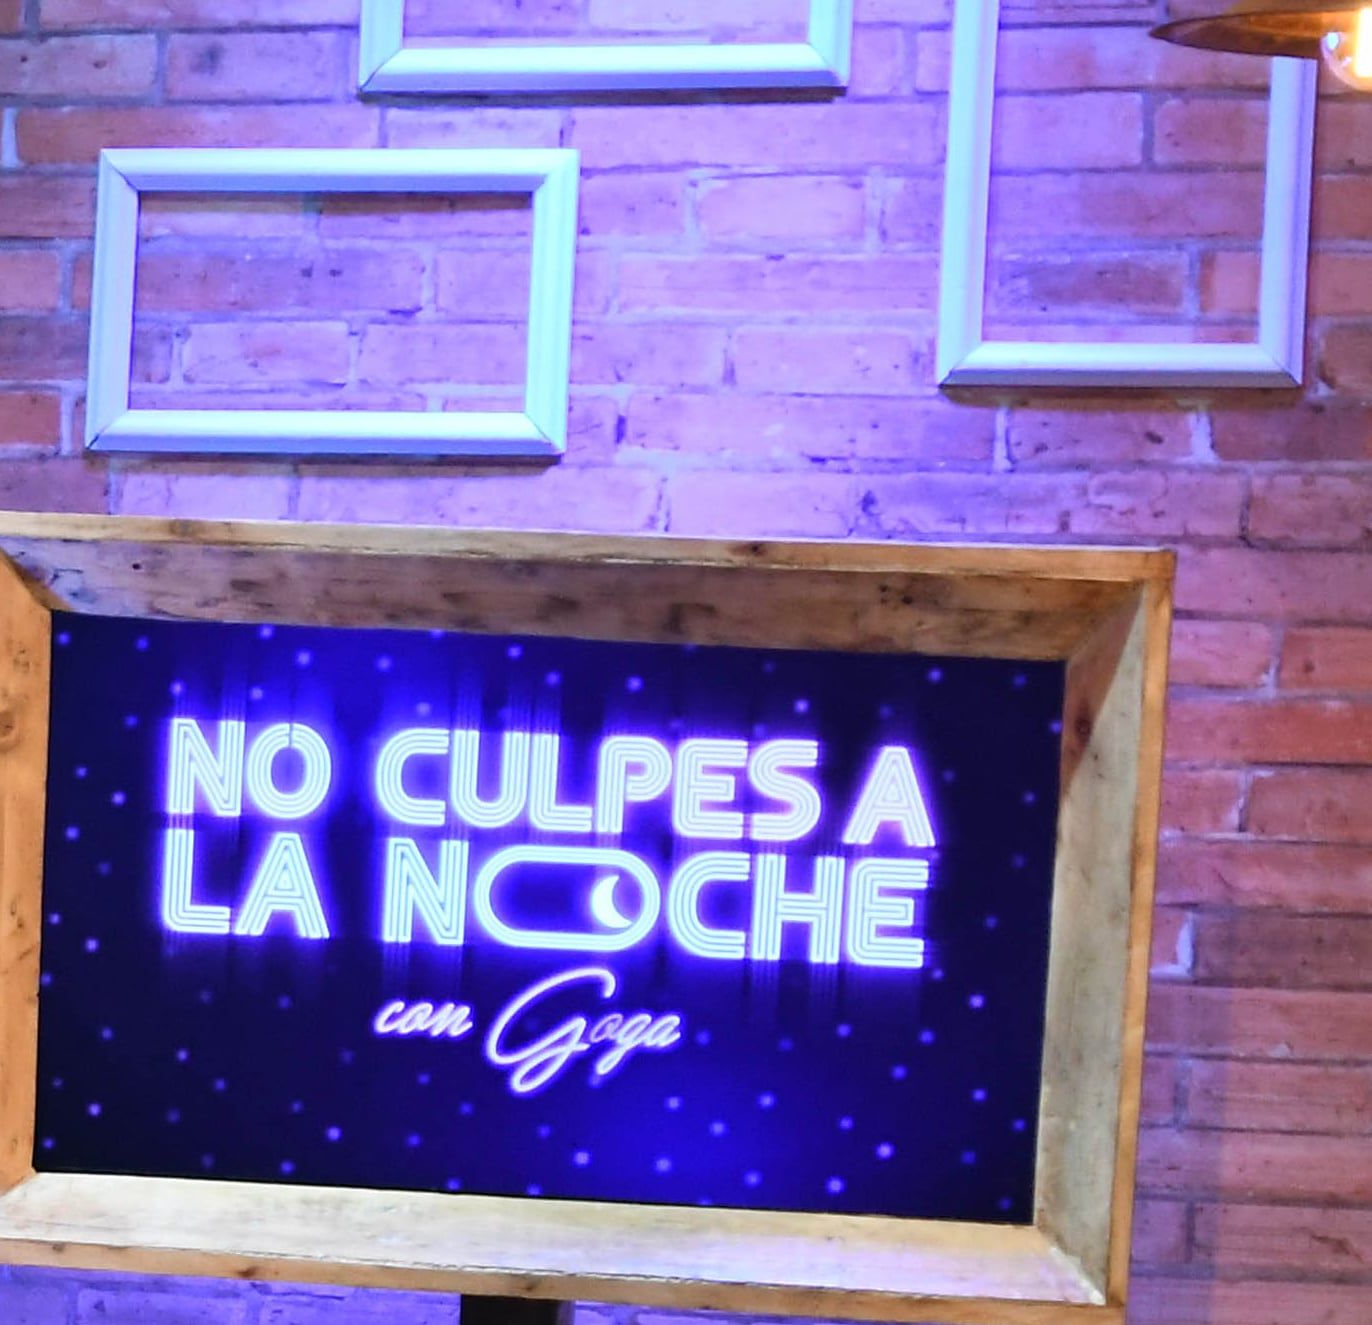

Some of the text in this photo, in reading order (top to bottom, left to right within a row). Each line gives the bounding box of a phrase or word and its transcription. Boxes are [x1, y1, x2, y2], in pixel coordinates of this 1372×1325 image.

[166, 717, 937, 848] NO CULPES A
[162, 827, 930, 969] LA NOCHE
[372, 966, 682, 1093] con Goga
